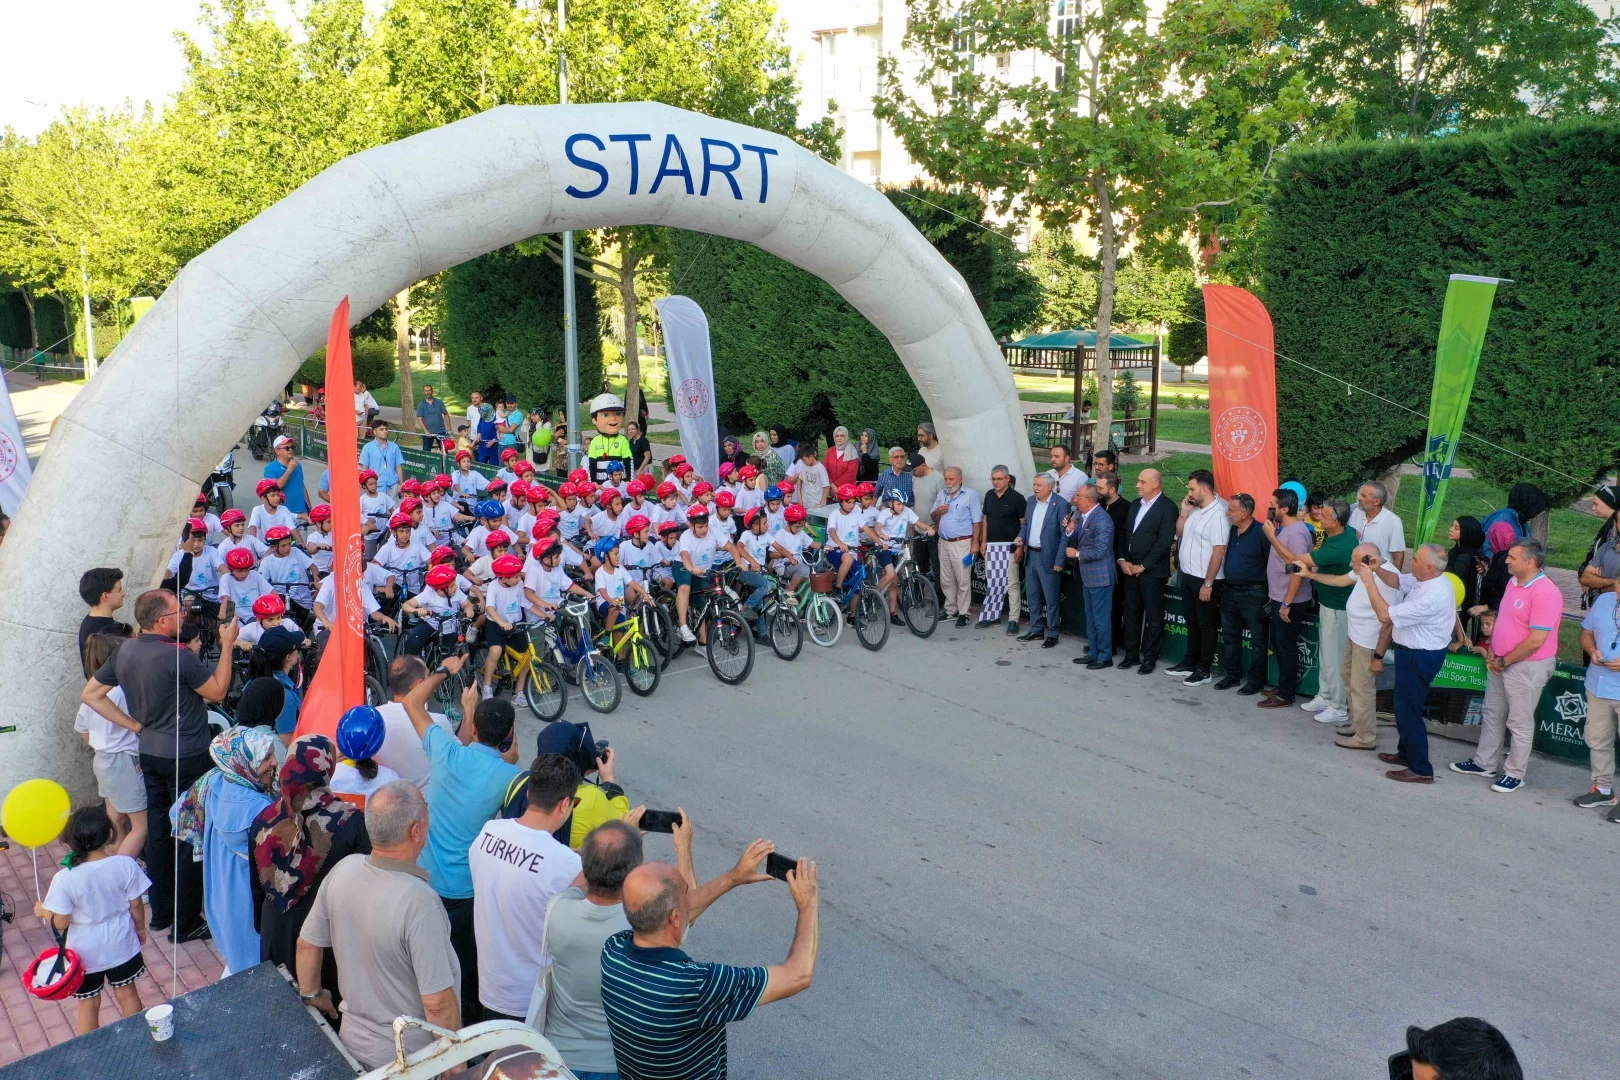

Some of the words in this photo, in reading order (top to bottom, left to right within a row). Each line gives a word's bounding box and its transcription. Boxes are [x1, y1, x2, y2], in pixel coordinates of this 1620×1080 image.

[564, 132, 779, 204] START
[1450, 671, 1468, 683] Spor
[1539, 720, 1585, 740] MERA
[480, 832, 545, 874] TÜRKİYE
